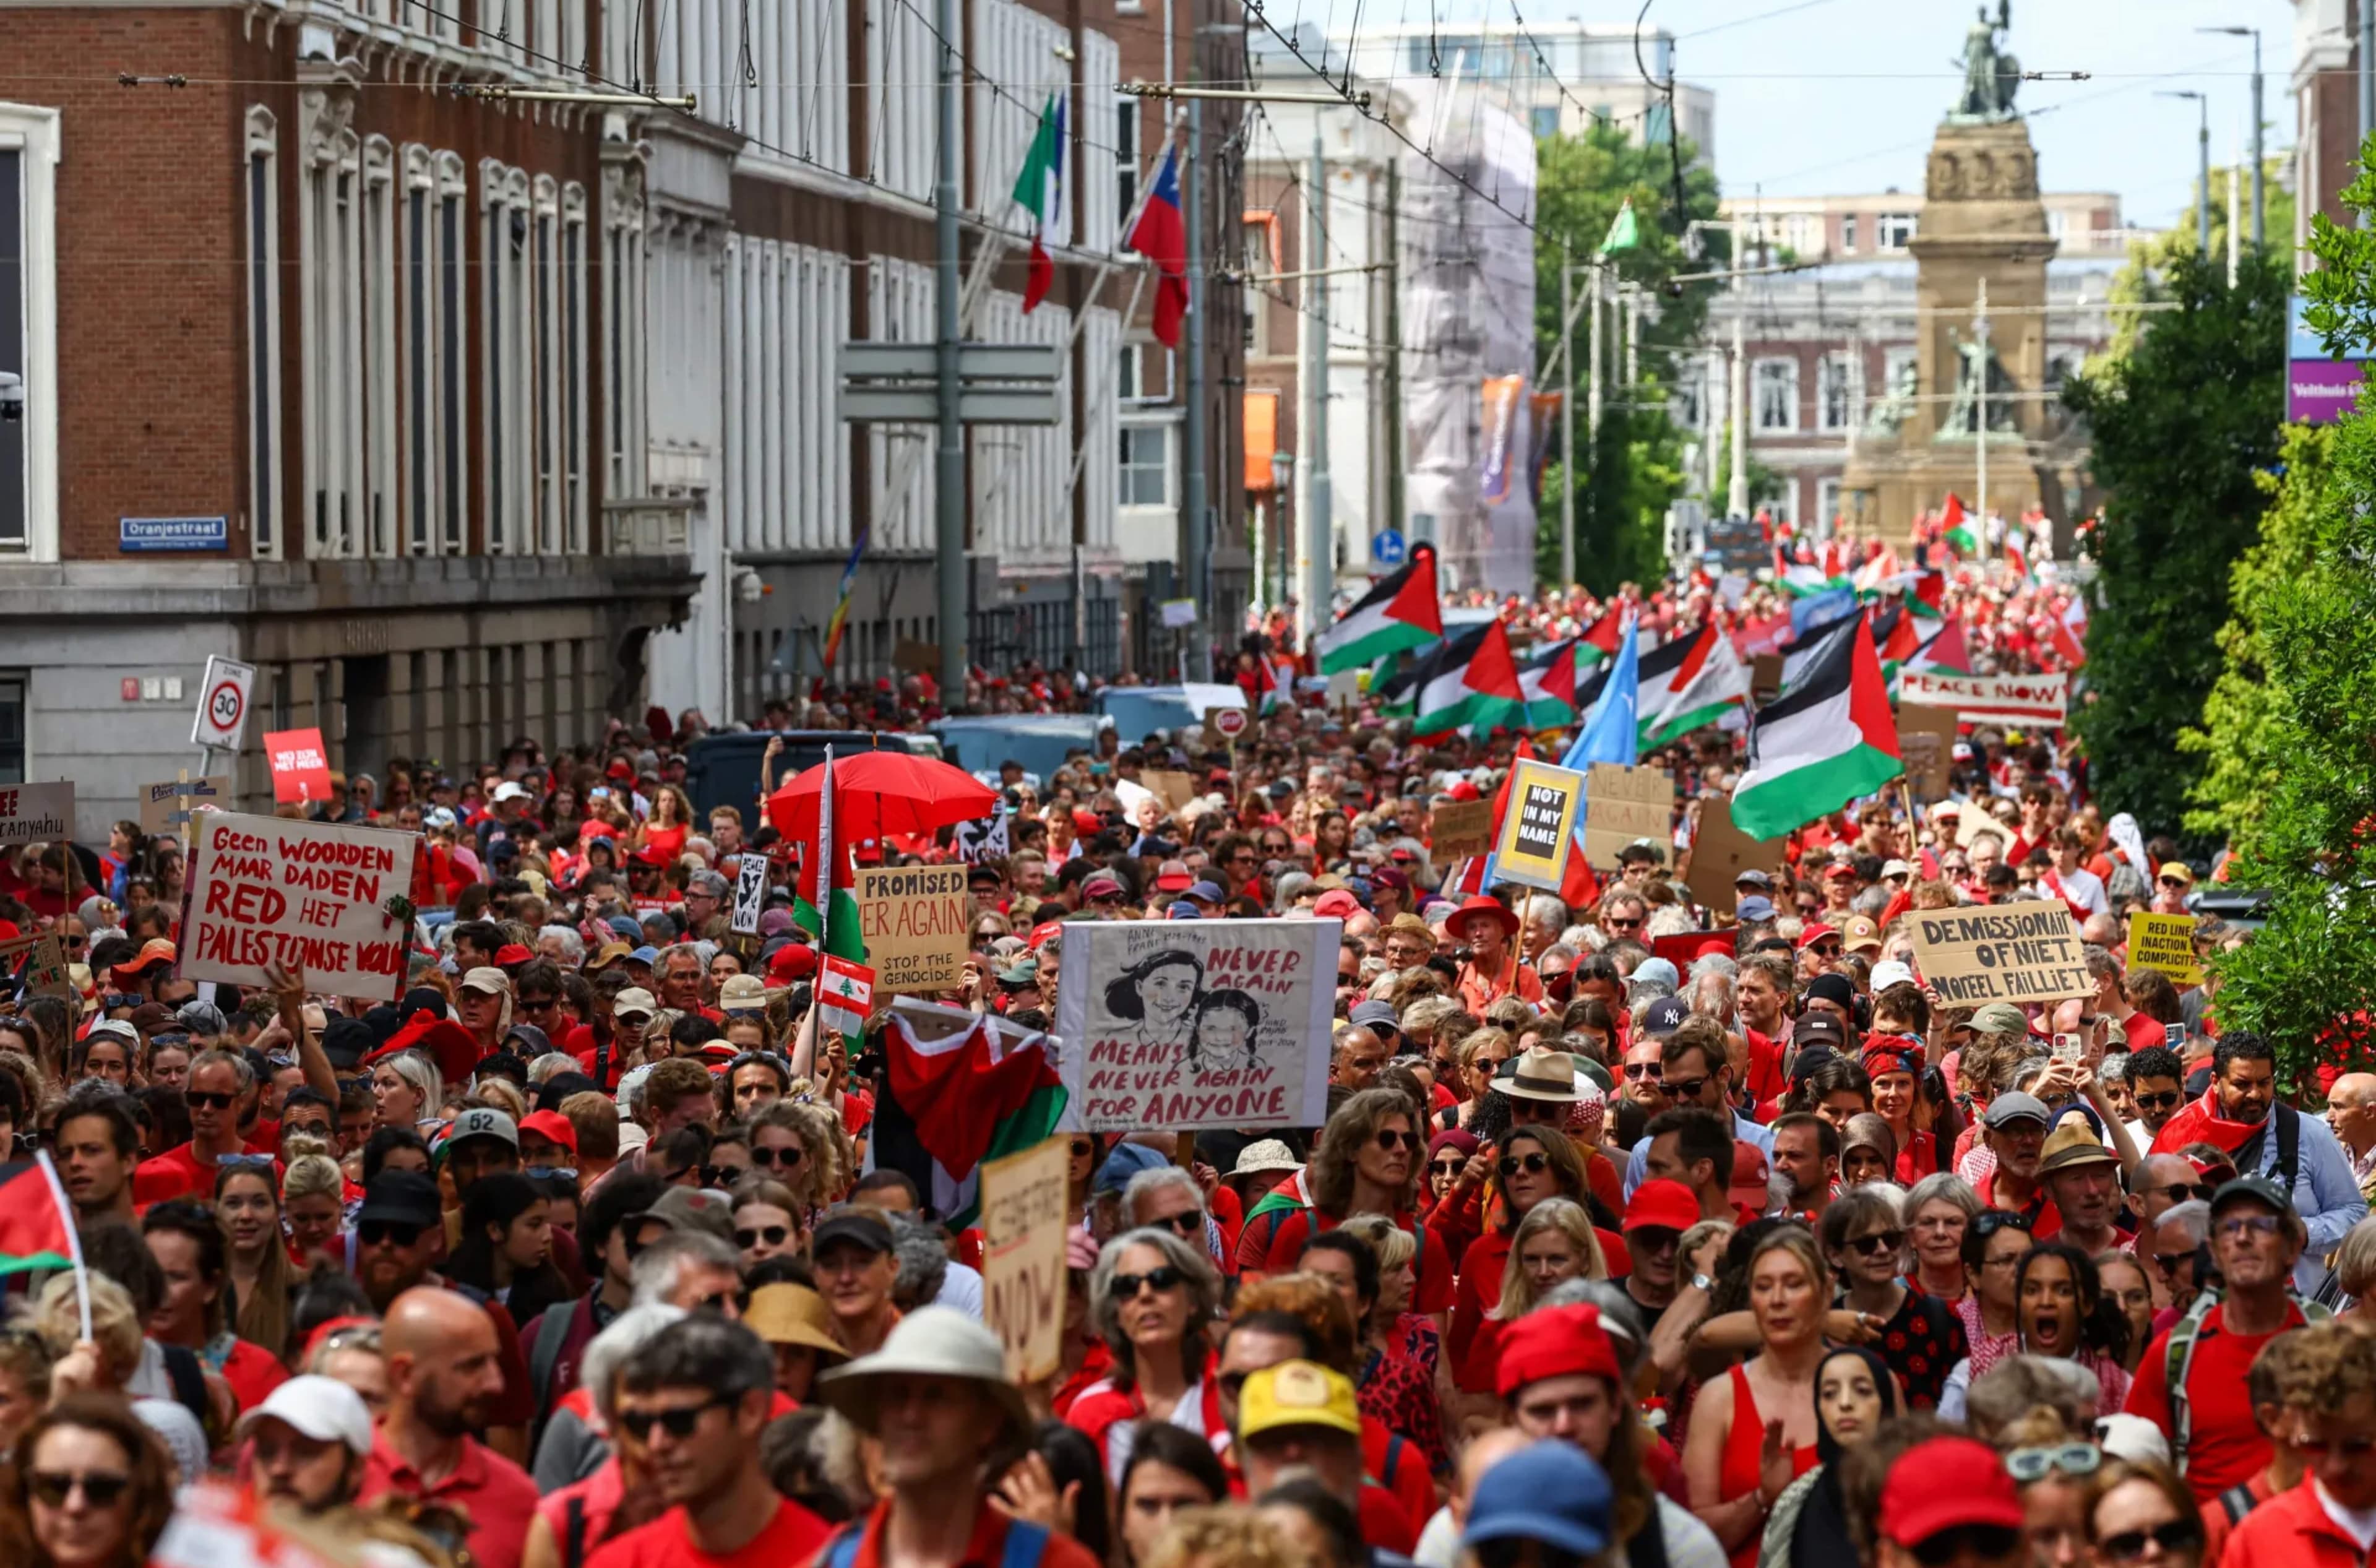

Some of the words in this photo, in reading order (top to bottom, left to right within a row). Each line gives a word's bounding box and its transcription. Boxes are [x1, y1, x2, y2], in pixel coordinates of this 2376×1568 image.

[129, 522, 217, 538] Oranjestraat
[223, 666, 242, 678] ZONE
[1903, 676, 1984, 697] PEACE
[1994, 683, 2057, 702] NOW
[215, 694, 238, 716] 30
[1531, 786, 1562, 805] NOT
[1523, 805, 1538, 821] IN
[1539, 808, 1562, 825] MY
[1520, 824, 1557, 845] NAME
[213, 827, 268, 853] Geen
[278, 837, 394, 872] WOORDEN
[210, 853, 273, 881] MAAR
[285, 864, 379, 904] DADEN
[205, 880, 286, 924] RED
[299, 897, 347, 928] HET
[2148, 922, 2167, 935] RED
[2170, 924, 2190, 937] LINE
[2141, 936, 2187, 952] INACTION
[884, 955, 920, 970] STOP
[926, 952, 953, 966] THE
[1207, 947, 1301, 974] NEVER
[1976, 942, 2010, 968] OF
[1664, 1009, 1679, 1024] NY
[1088, 1039, 1184, 1066] MEANS
[1088, 1069, 1181, 1090] NEVER
[1085, 1095, 1137, 1118] FOR
[1141, 1085, 1286, 1124] ANYONE
